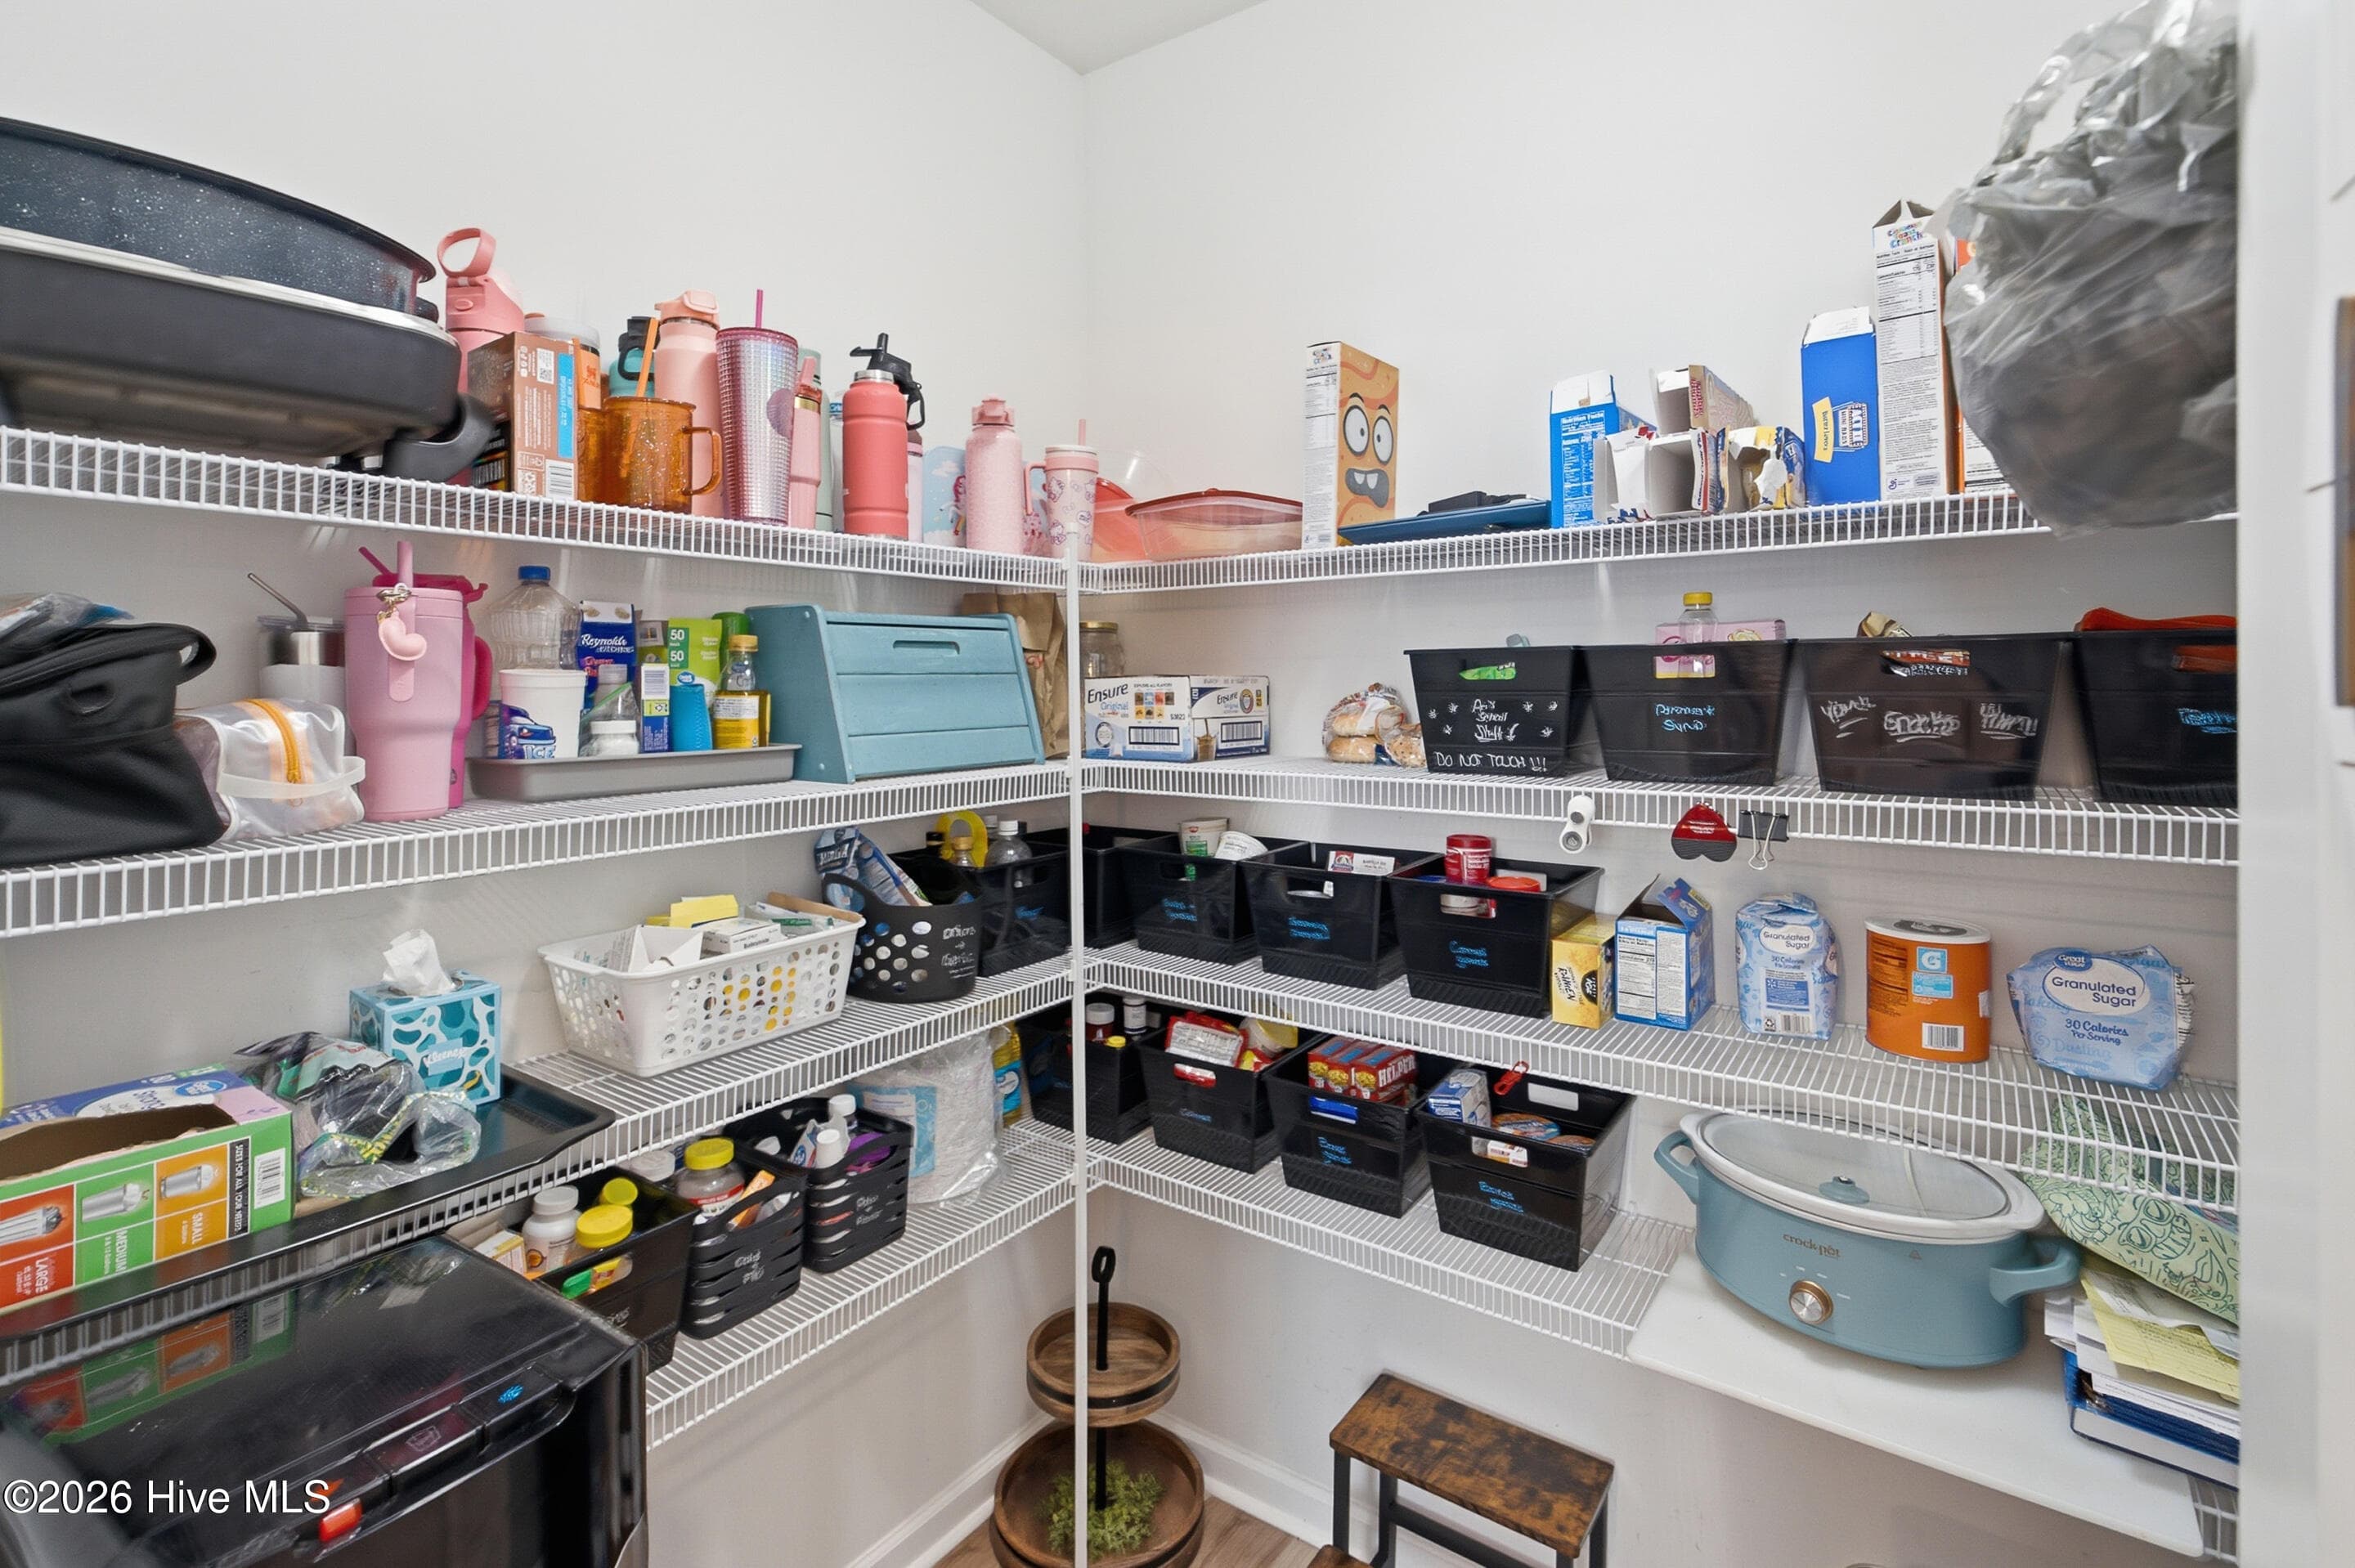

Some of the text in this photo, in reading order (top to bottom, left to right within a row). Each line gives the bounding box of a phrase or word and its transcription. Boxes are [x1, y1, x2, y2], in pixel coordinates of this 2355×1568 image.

[671, 629, 685, 641] 50
[671, 650, 684, 661] 50
[1088, 683, 1128, 704] Ensure
[1434, 751, 1453, 767] DO
[1763, 931, 1810, 942] Granulated
[1785, 940, 1810, 950] Sugar
[2057, 954, 2085, 964] Great
[2052, 976, 2137, 996] Granulated
[2093, 992, 2137, 1007] Sugar
[2065, 1018, 2129, 1037] 30 Calories
[2087, 1032, 2121, 1046] Serving
[191, 1212, 204, 1244] SMALL
[115, 1230, 128, 1272] MEDIUM
[35, 1257, 49, 1293] LARGE
